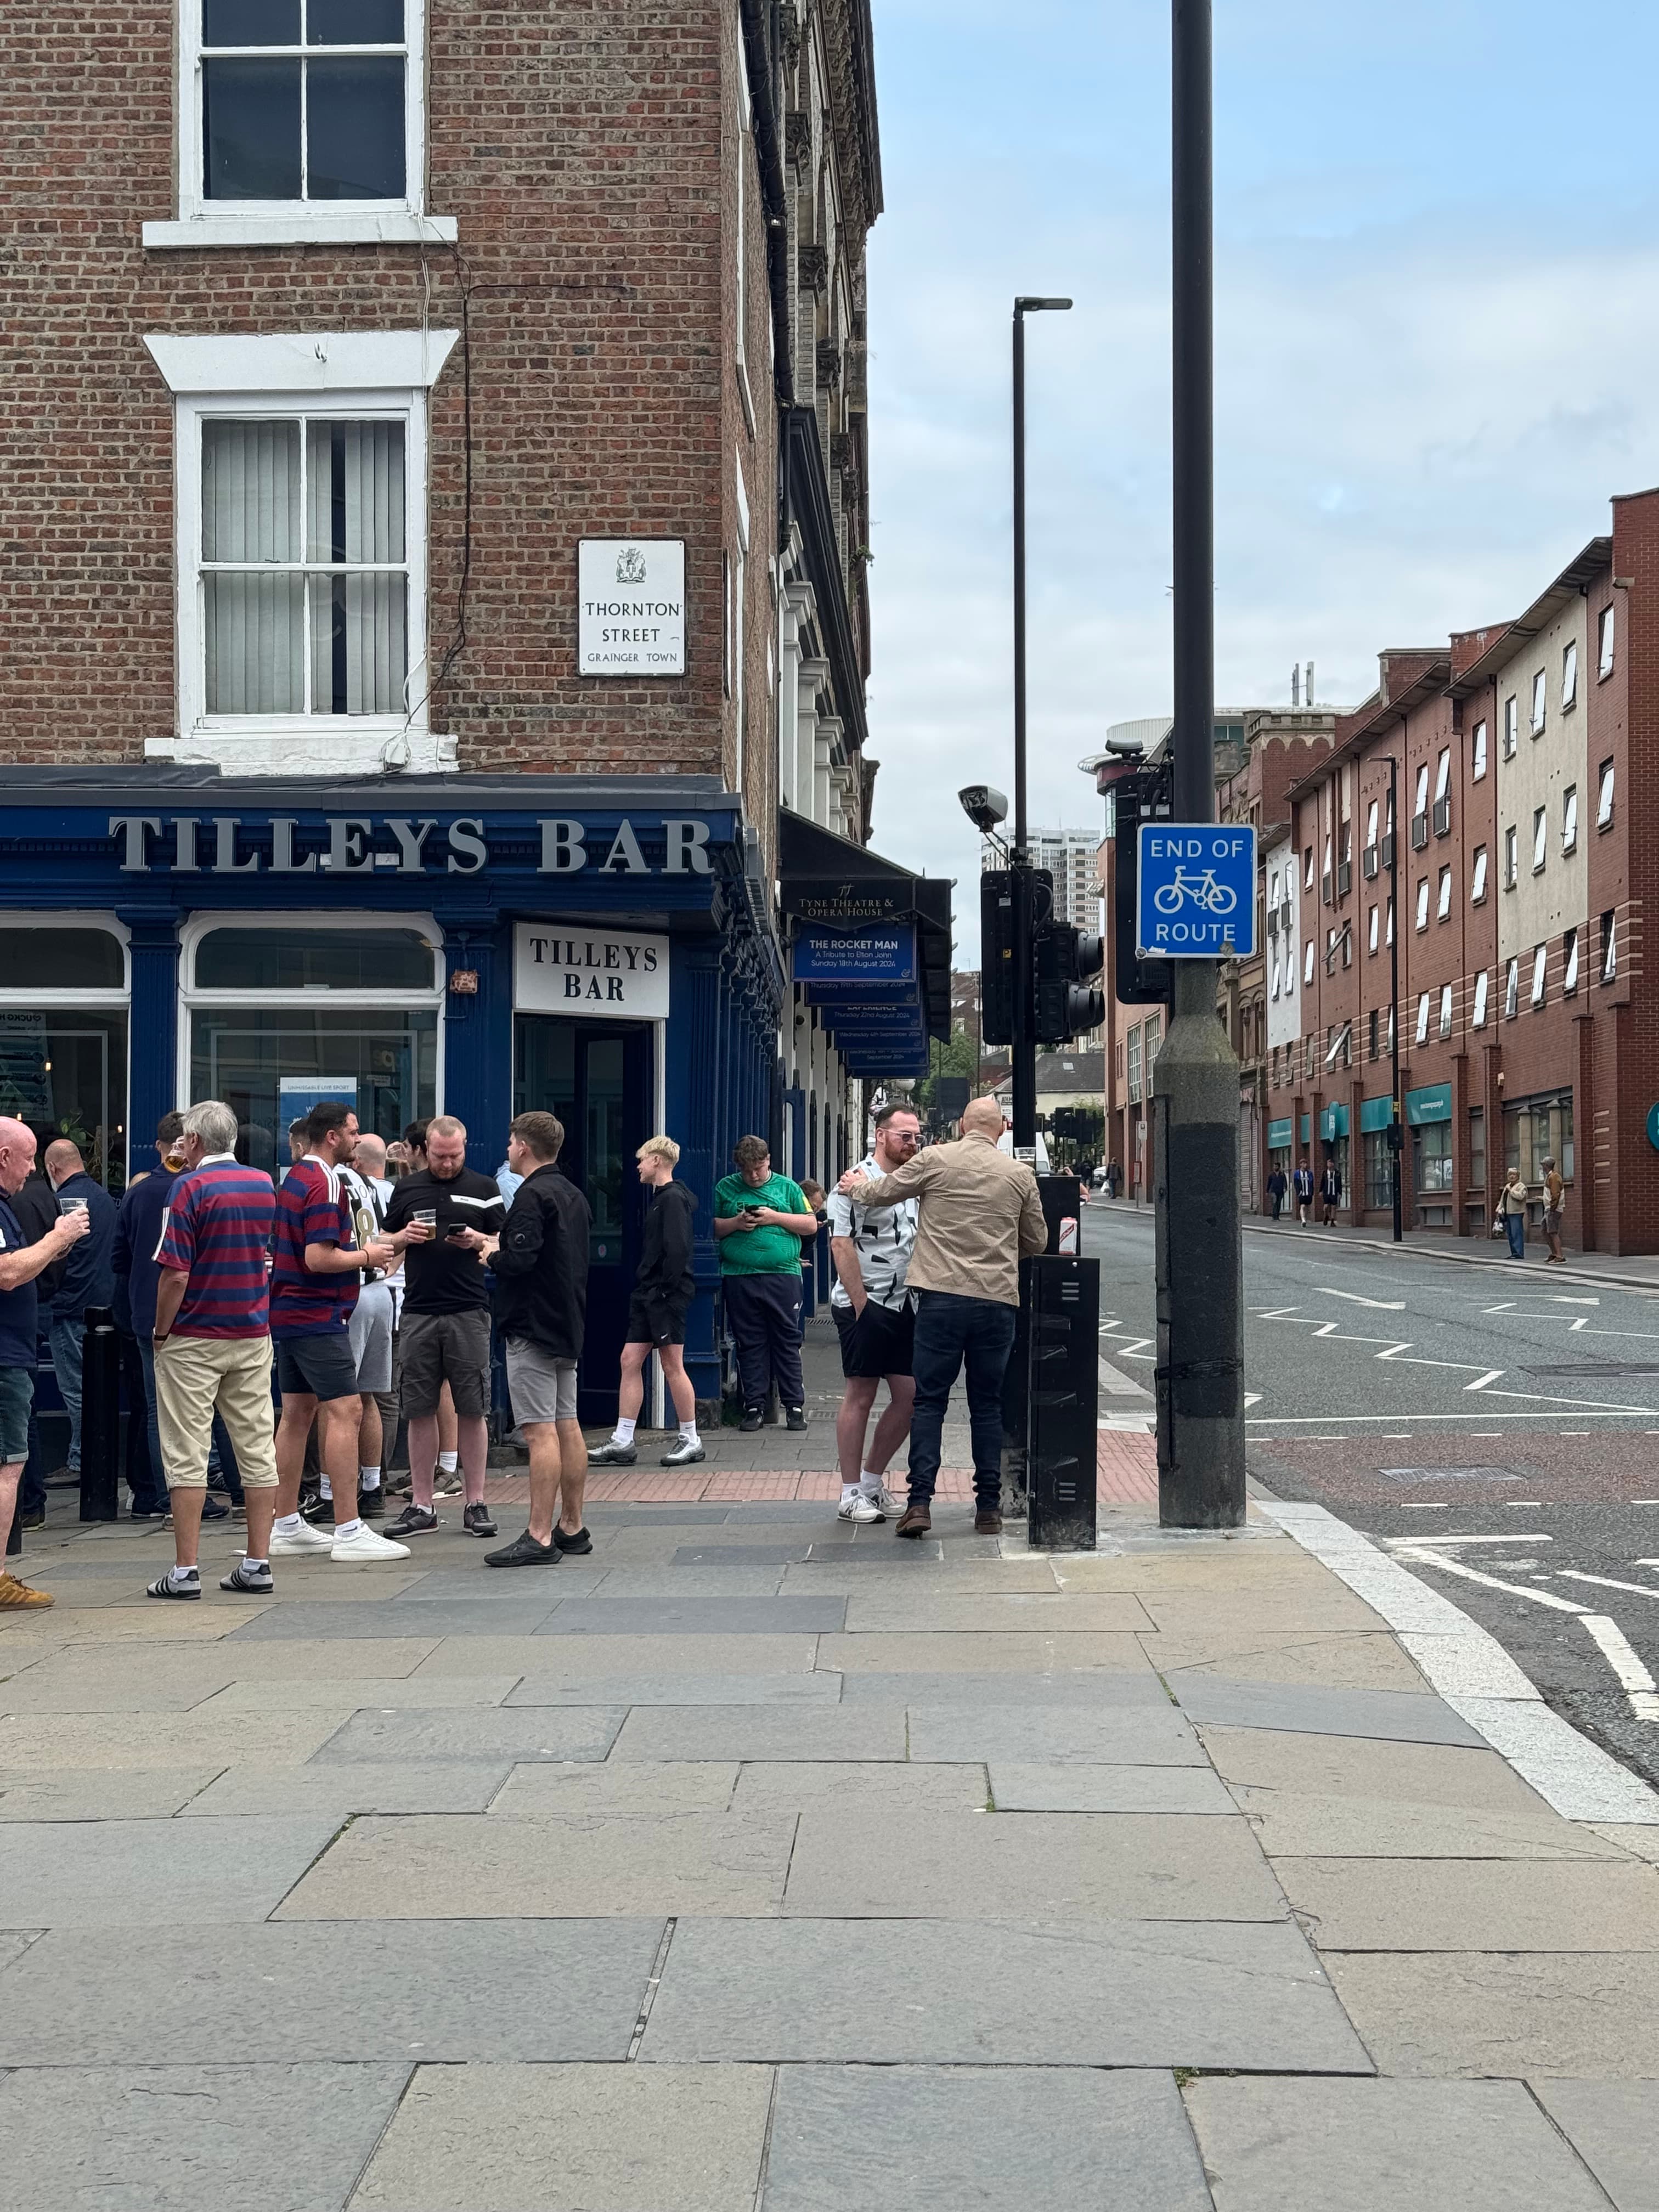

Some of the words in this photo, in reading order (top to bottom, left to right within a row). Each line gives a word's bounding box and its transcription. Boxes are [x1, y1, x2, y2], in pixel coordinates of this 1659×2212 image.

[585, 602, 680, 616] THORNTON
[602, 629, 660, 642] STREET
[588, 653, 639, 662] GRAINGER
[646, 653, 678, 662] TOWN
[109, 816, 488, 874] TILLEYS
[536, 819, 715, 874] BAR
[1150, 839, 1203, 858] END
[1211, 839, 1244, 858] OF
[799, 899, 828, 907] TYNE
[831, 898, 881, 907] THEATRE
[884, 898, 894, 907] &
[808, 908, 843, 917] OPERA
[847, 907, 883, 916] HOUSE
[1156, 923, 1236, 941] ROUTE
[809, 940, 828, 949] THE
[831, 940, 872, 949] ROCKET
[875, 941, 898, 950] MAN
[529, 938, 658, 972] TILLEYS
[563, 973, 625, 1001] BAR
